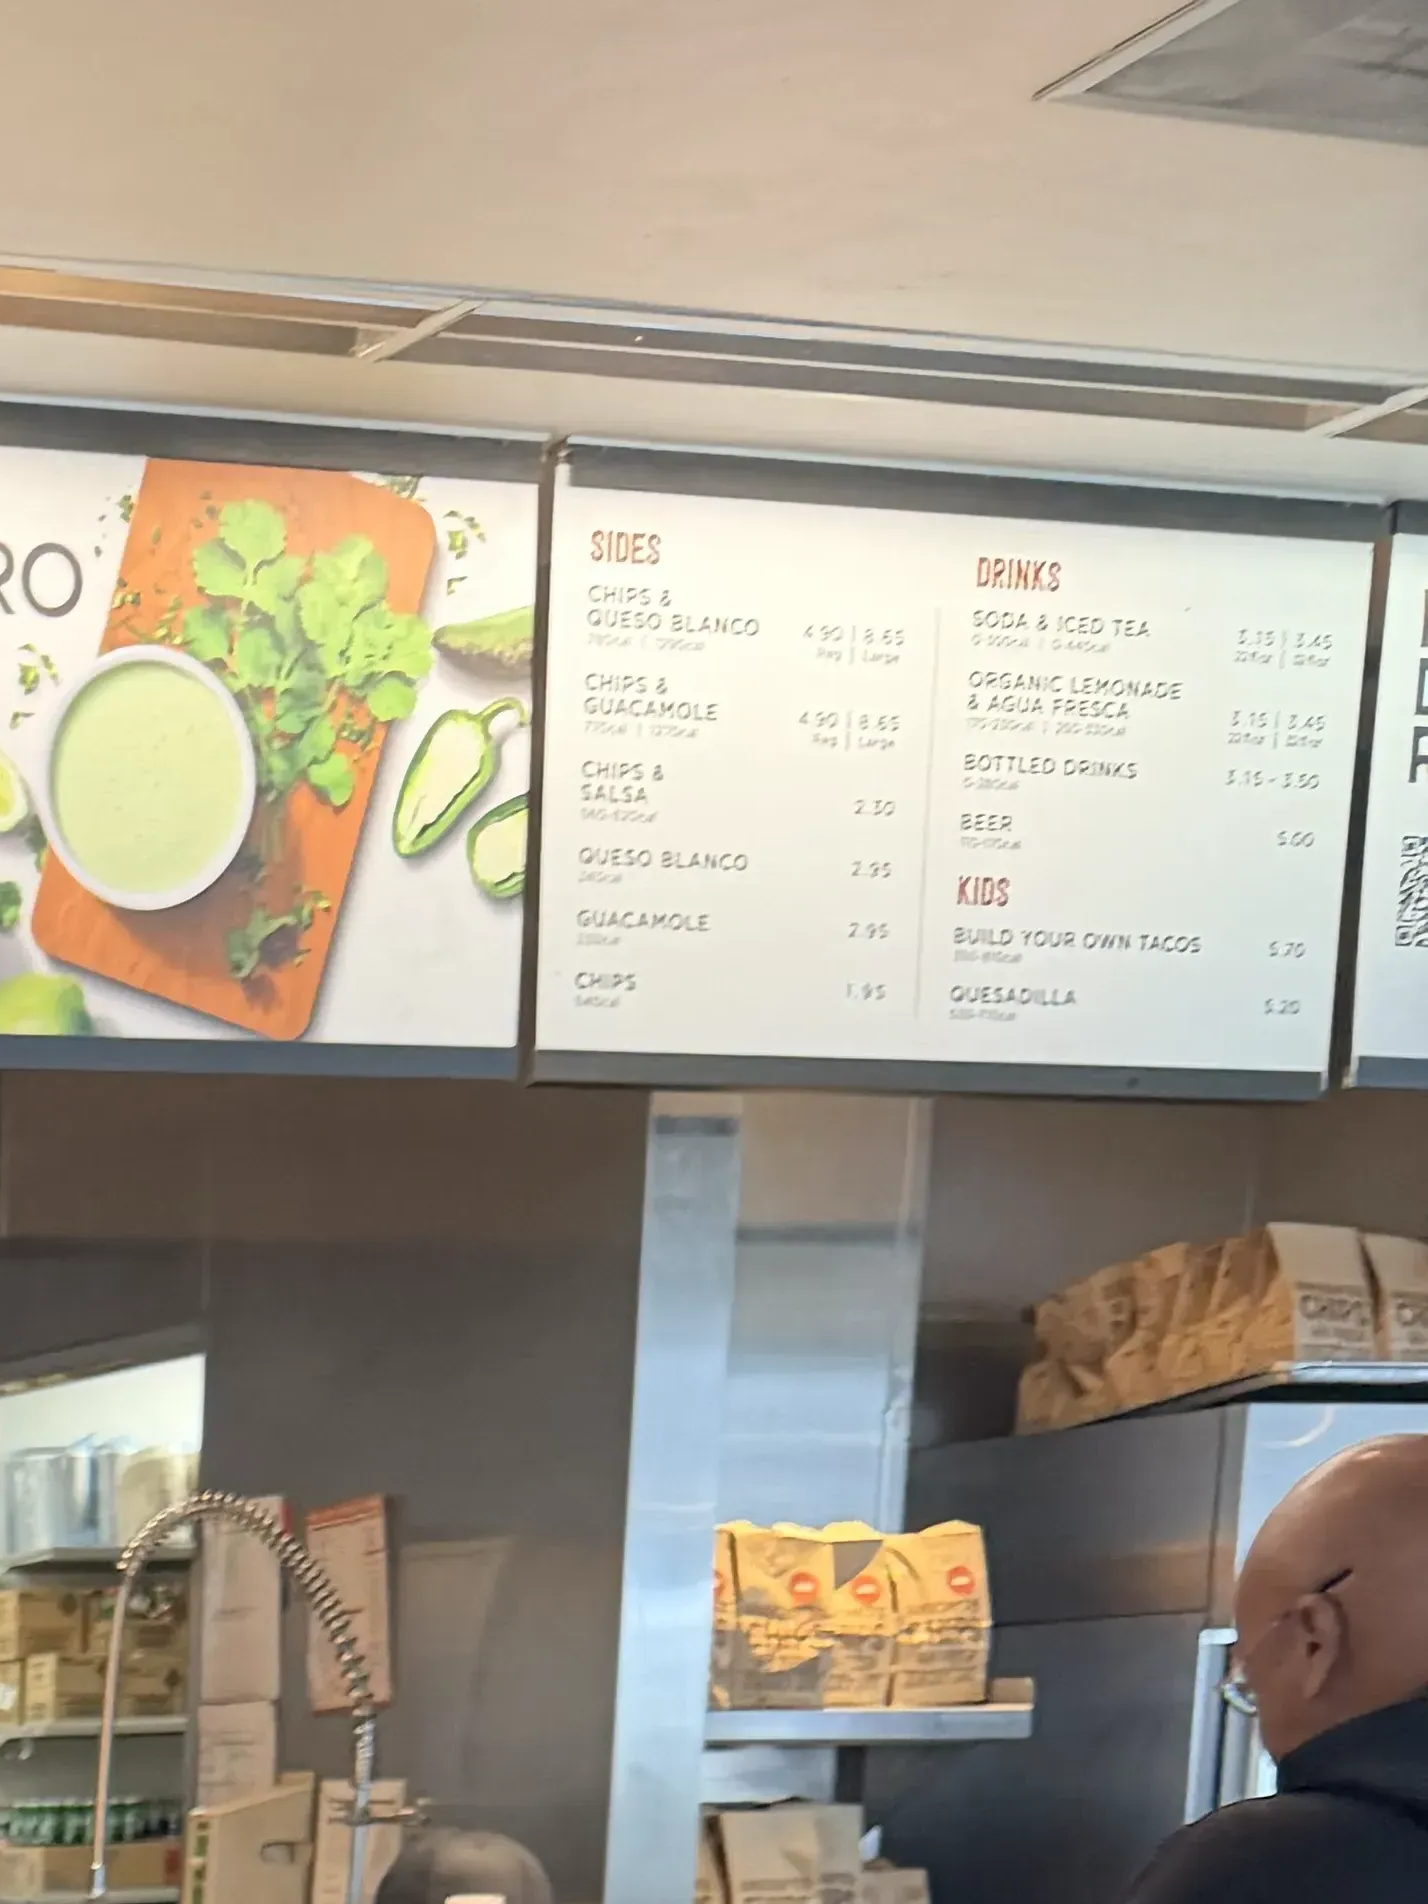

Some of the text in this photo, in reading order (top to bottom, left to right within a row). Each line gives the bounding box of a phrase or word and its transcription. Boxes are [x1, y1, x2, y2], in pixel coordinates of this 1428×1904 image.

[590, 530, 662, 565] SIDES
[976, 556, 1062, 593] DRINKS
[588, 585, 672, 607] CHIPS &
[587, 608, 760, 636] QUESO BLANCO
[972, 610, 1029, 630] SODA
[1058, 616, 1104, 635] ICED
[1112, 619, 1151, 638] TEA
[585, 672, 668, 695] CHIPS &
[968, 671, 1184, 700] ORGANIC LEMONADE
[583, 697, 719, 721] GUACAMOLE
[987, 695, 1044, 714] AGUA
[1051, 698, 1131, 720] FRESCA
[581, 760, 664, 782] CHIPS &
[964, 753, 1139, 780] BOTTLED DRINKS
[581, 784, 648, 804] SALSA
[960, 813, 1013, 832] BEER
[579, 847, 748, 872] QUESO BLANCO
[957, 875, 1011, 907] KIDS
[577, 909, 710, 932] GUACAMOLE
[954, 927, 1203, 954] BUILD YOUR OWN TACOS
[949, 985, 1077, 1006] QUESADILLA
